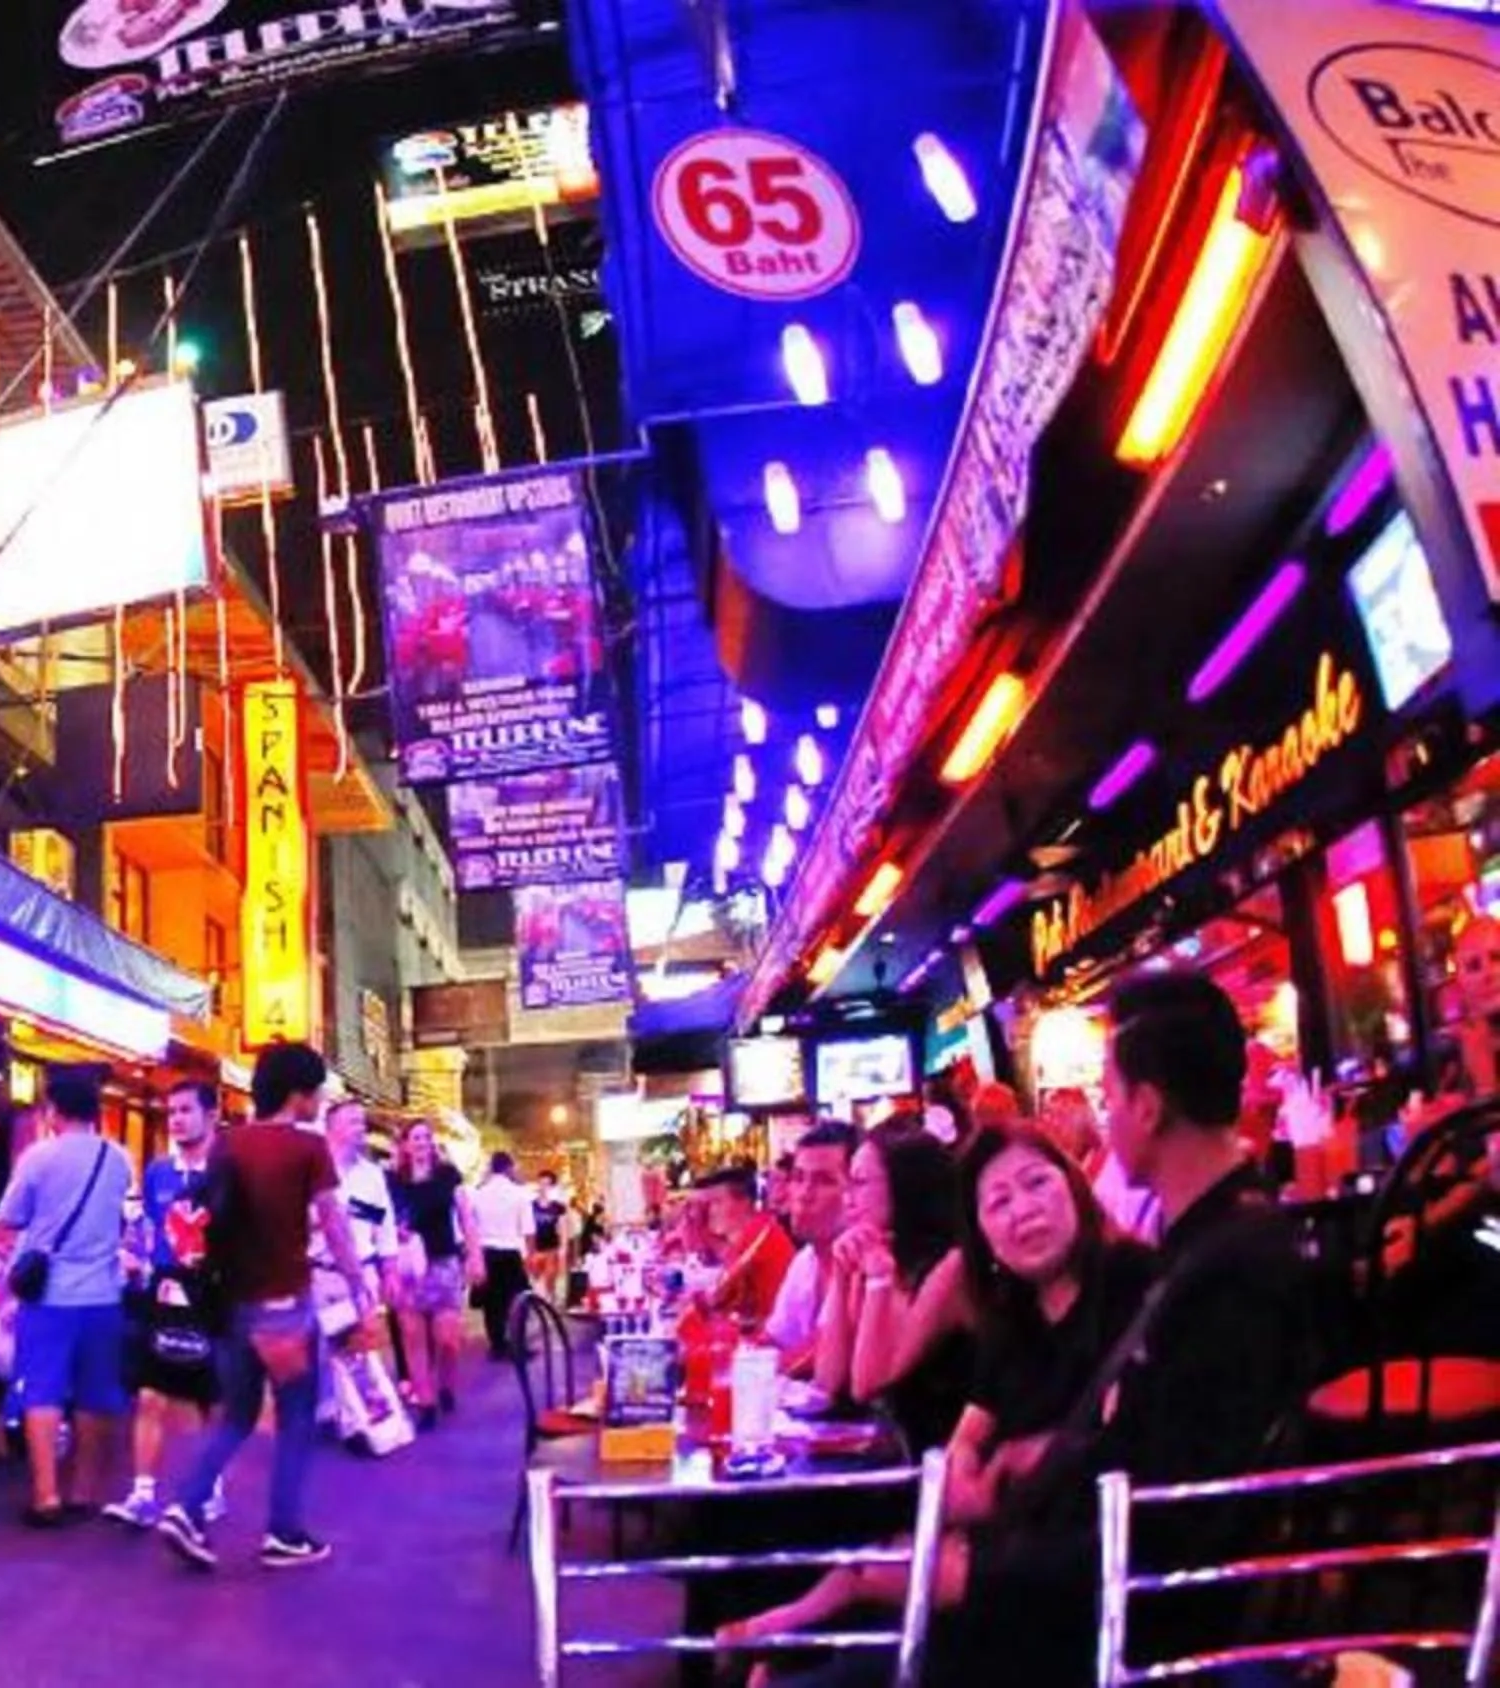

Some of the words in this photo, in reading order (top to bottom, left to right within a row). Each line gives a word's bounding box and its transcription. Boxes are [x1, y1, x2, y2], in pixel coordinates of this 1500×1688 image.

[677, 157, 823, 247] 65
[725, 250, 820, 276] Baht
[451, 713, 609, 750] TELEPHONE
[1193, 776, 1223, 856] &
[1221, 652, 1361, 831] Karaoke
[257, 691, 289, 951] SPANISH
